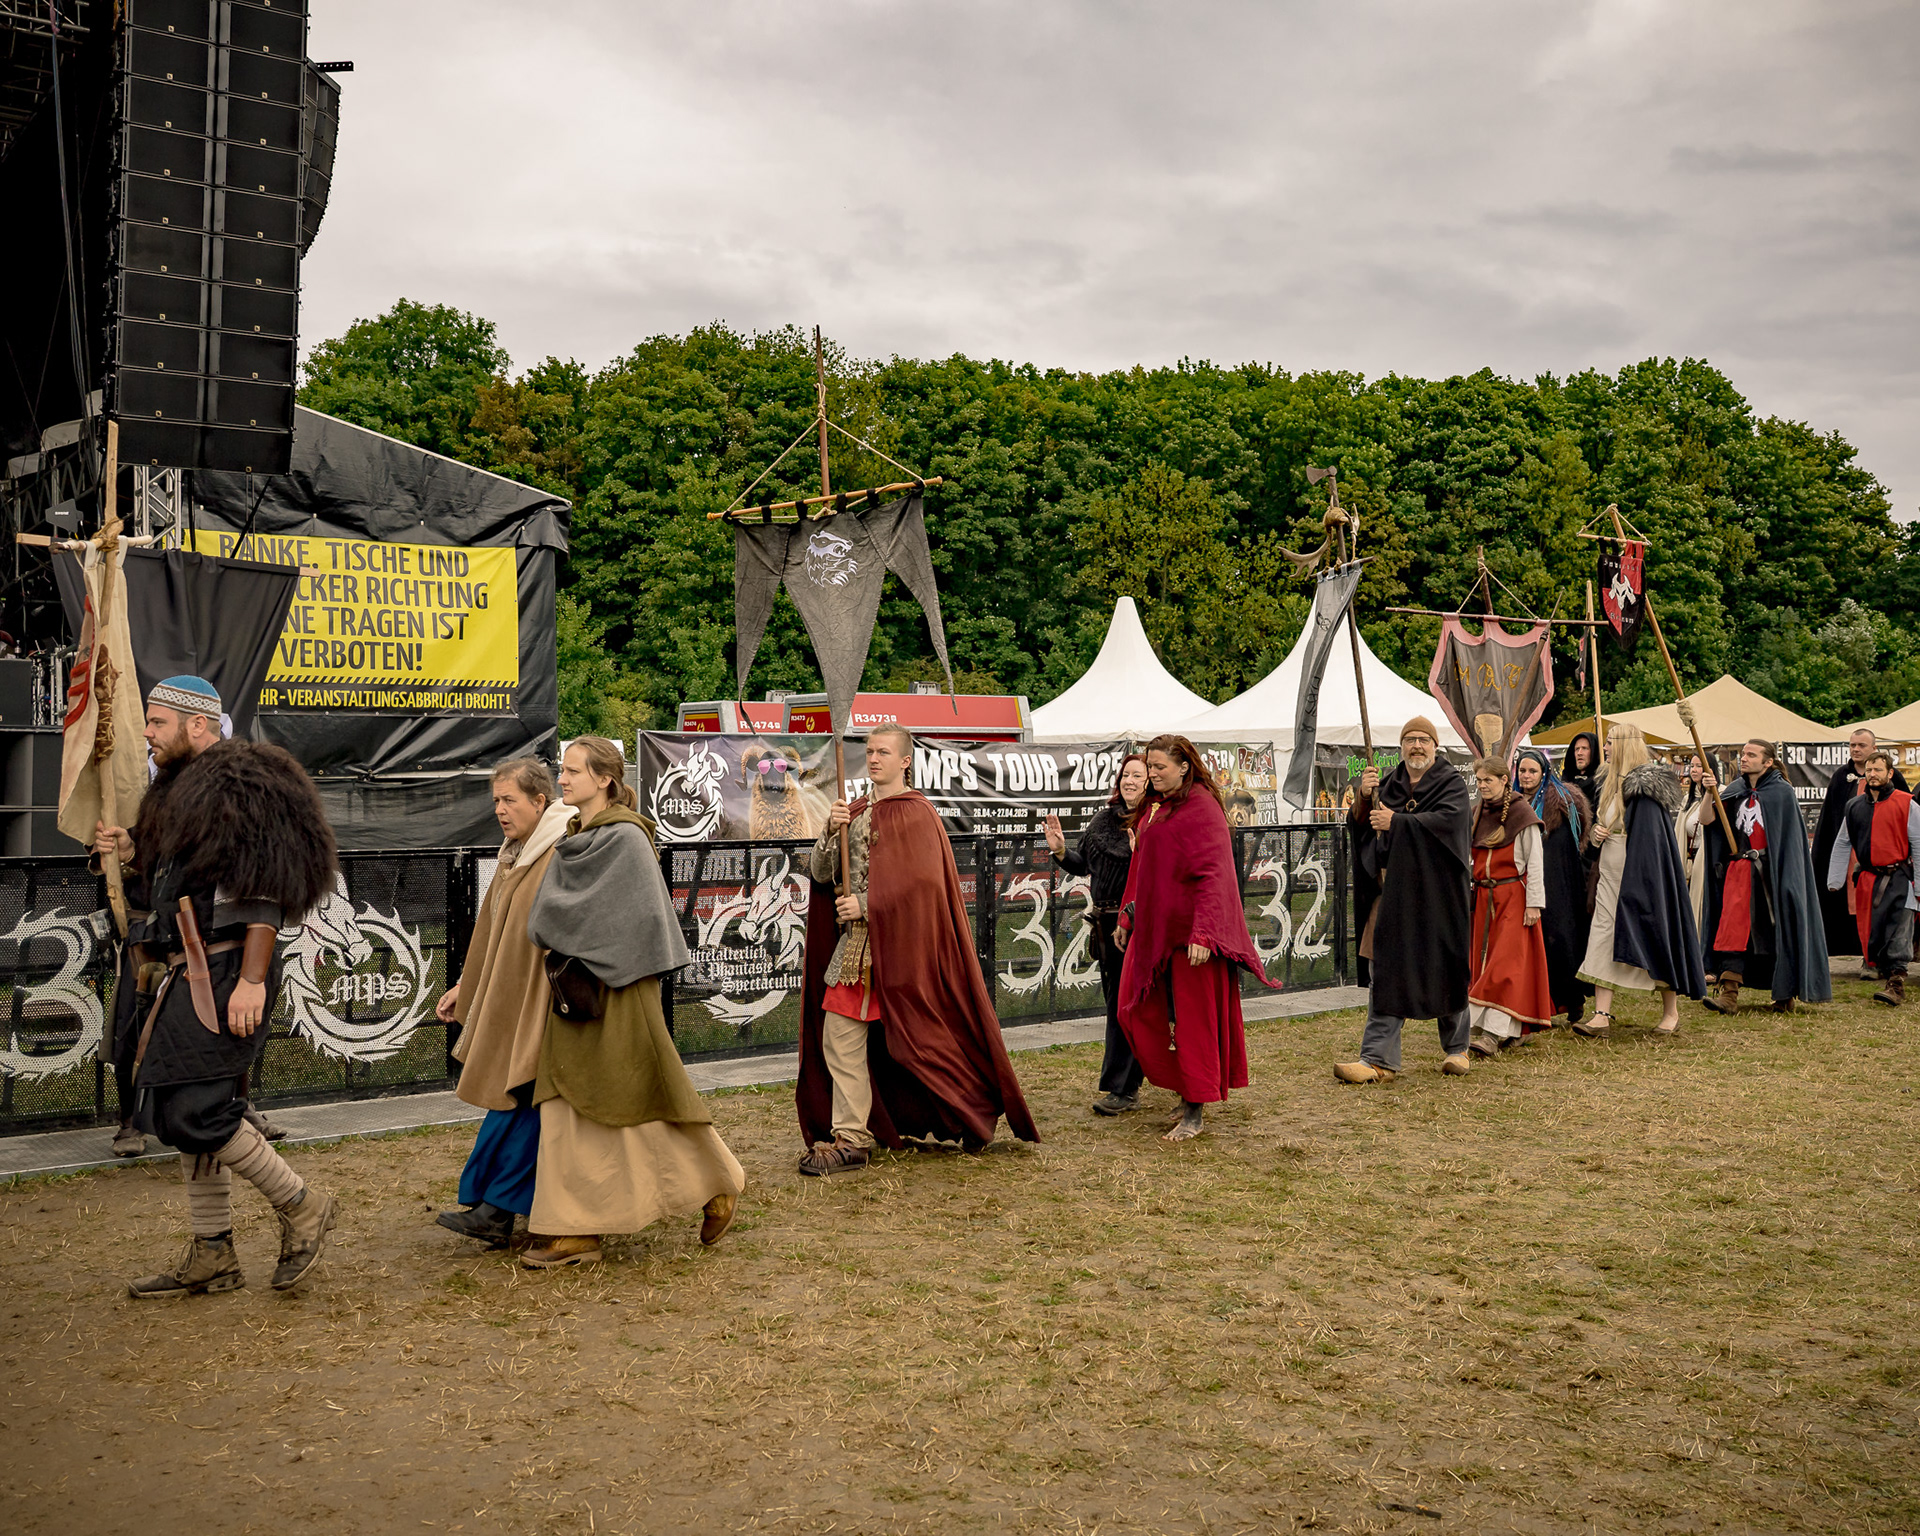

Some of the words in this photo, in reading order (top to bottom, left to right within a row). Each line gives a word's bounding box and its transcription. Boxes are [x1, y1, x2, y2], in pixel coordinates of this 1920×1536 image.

[325, 541, 411, 574] TISCHE
[418, 549, 470, 577] UND
[294, 575, 359, 604] CKER
[367, 577, 488, 609] RICHTUNG
[283, 605, 316, 634] NE
[322, 607, 425, 638] TRAGEN
[432, 612, 469, 640] IST
[279, 638, 423, 671] VERBOTEN!
[465, 693, 511, 709] DROHT!
[739, 720, 775, 730] R474
[1787, 746, 1806, 765] 30
[1812, 747, 1851, 765] JAHR
[913, 748, 979, 791] MPS
[986, 753, 1060, 792] TOUR
[1067, 751, 1123, 791] 2025
[1793, 786, 1828, 800] INTFLU
[660, 798, 704, 817] MPS
[934, 807, 961, 817] CKINGEN
[688, 945, 767, 963] ittelalterlich
[707, 961, 774, 980] Phantasie
[325, 972, 412, 1005] MPS
